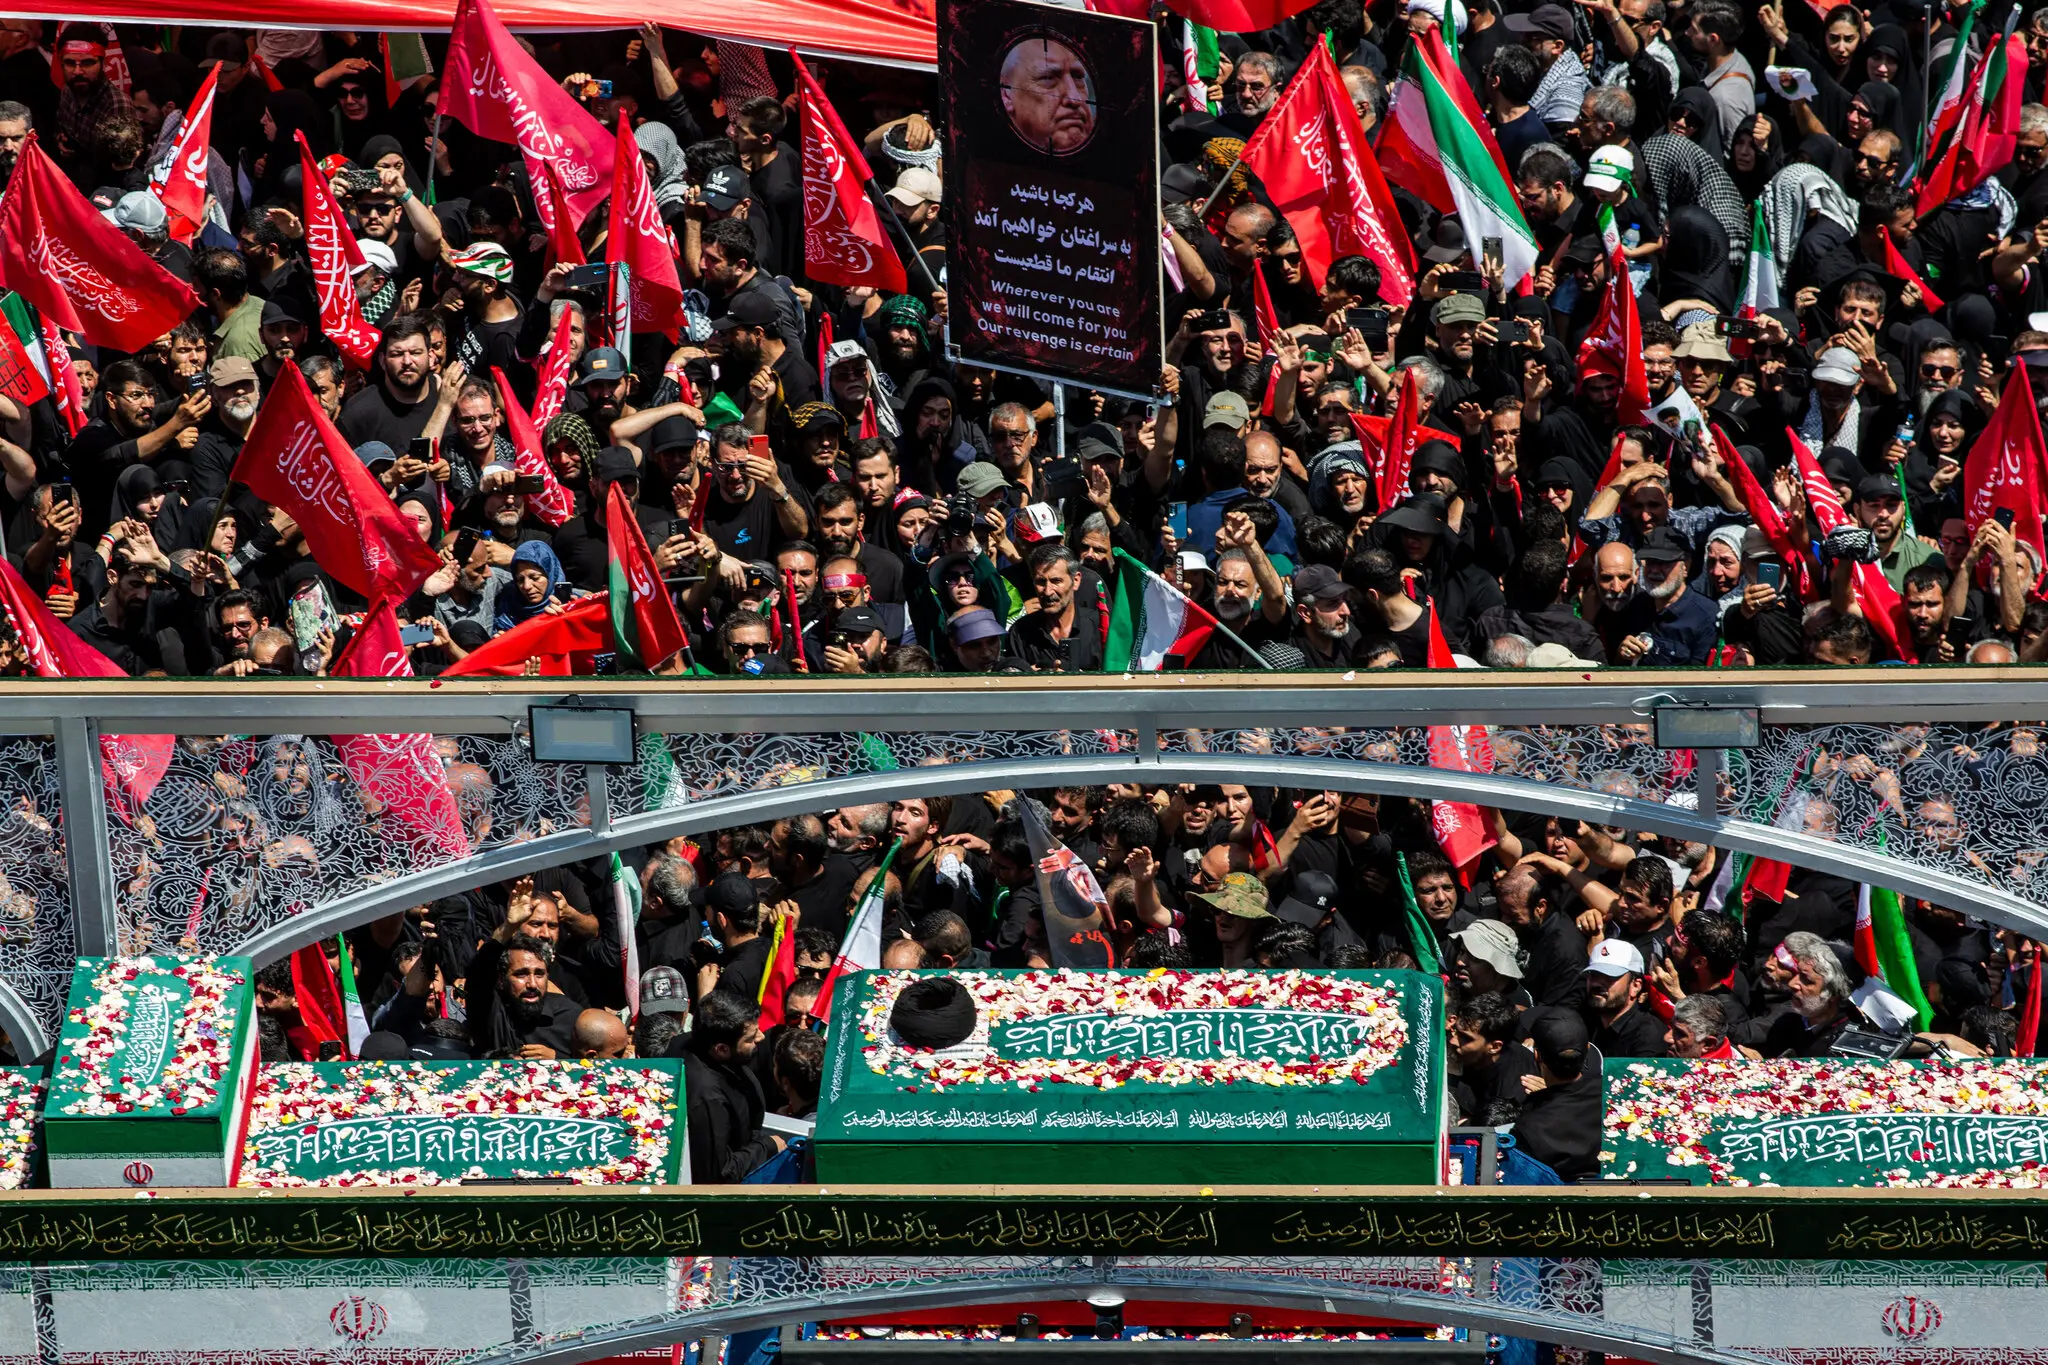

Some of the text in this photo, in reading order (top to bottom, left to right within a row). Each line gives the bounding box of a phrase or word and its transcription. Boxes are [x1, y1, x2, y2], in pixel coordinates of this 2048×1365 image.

[1011, 183, 1095, 214] هر کجا باشید
[974, 207, 1131, 259] به سراغتان خواهیم آمد
[994, 249, 1115, 284] انتقام ما قطعیست
[991, 280, 1120, 318] Wherever you are
[982, 301, 1127, 339] we will come for you
[977, 318, 1134, 361] Our revenge is certain
[1175, 558, 1184, 585] TOKYO
